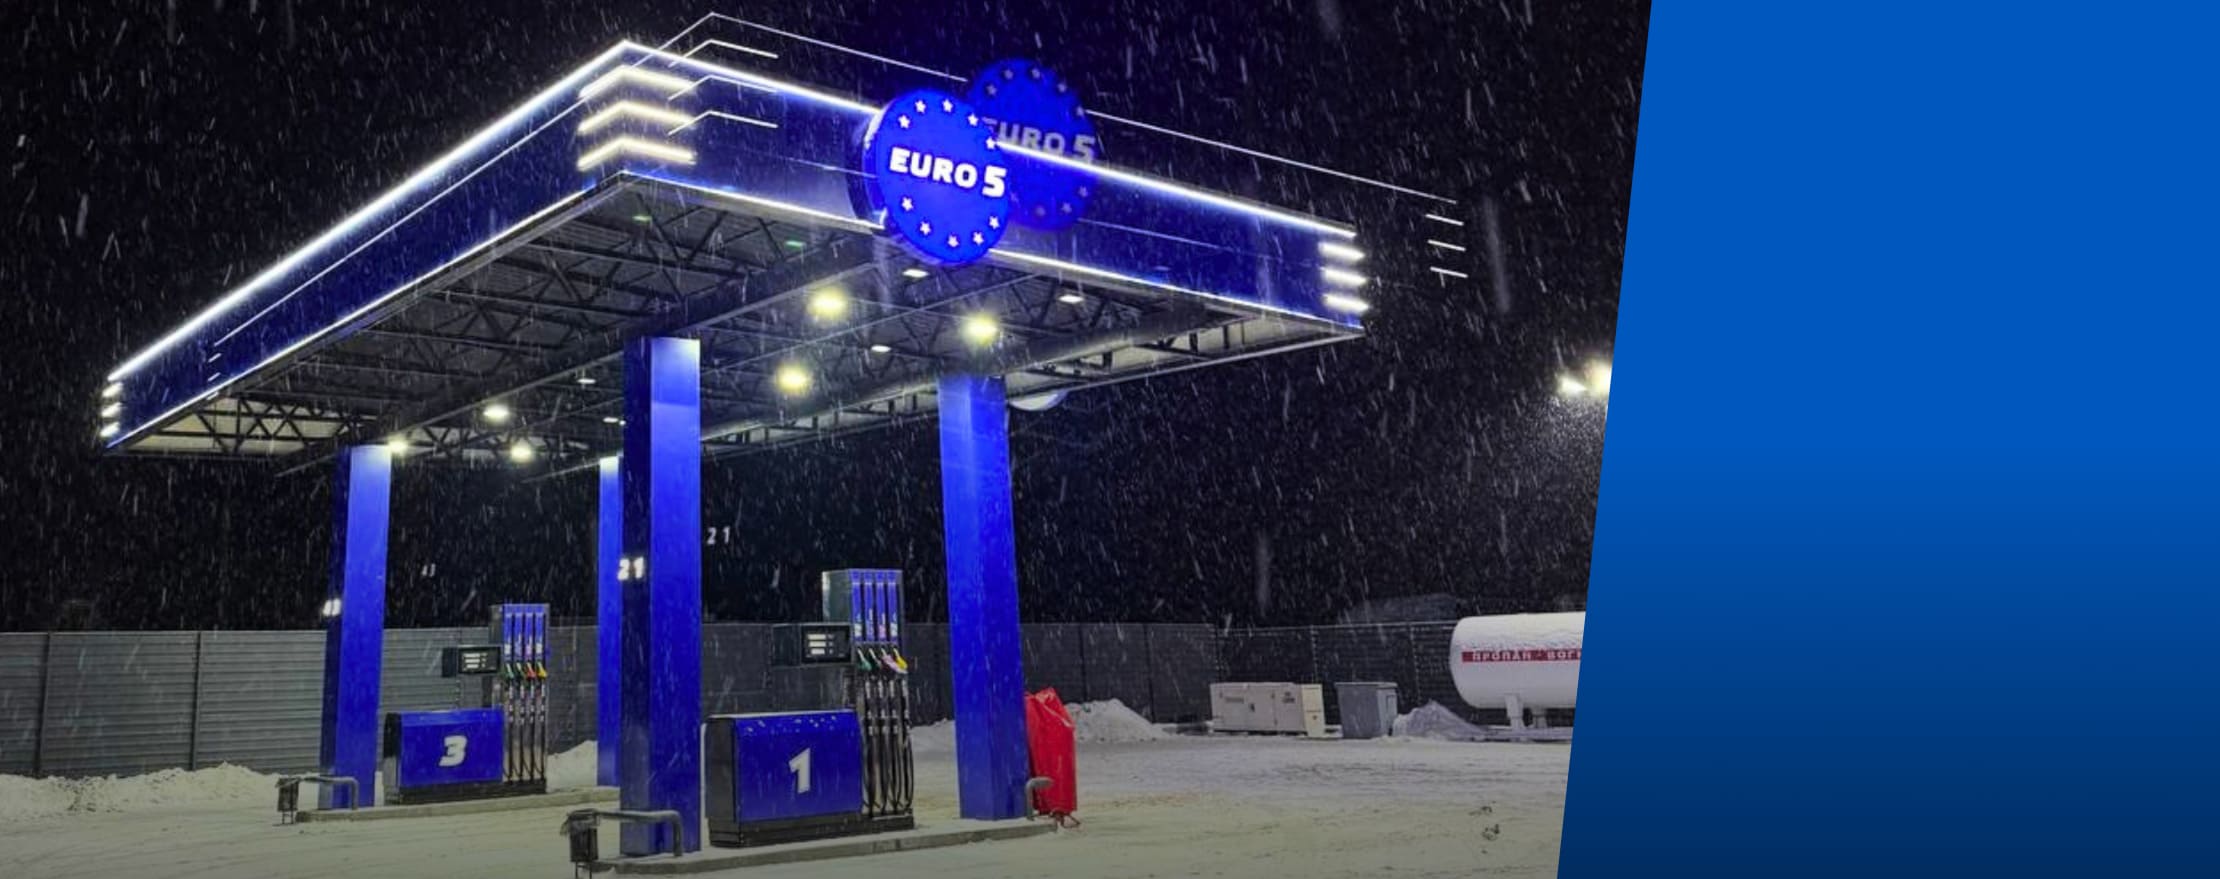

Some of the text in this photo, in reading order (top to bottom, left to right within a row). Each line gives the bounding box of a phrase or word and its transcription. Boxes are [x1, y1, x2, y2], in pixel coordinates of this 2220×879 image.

[1073, 134, 1096, 163] 5
[889, 147, 1007, 197] EURO 5
[1472, 649, 1531, 661] ПРОПАН
[439, 736, 467, 766] 3
[789, 748, 810, 793] 1
